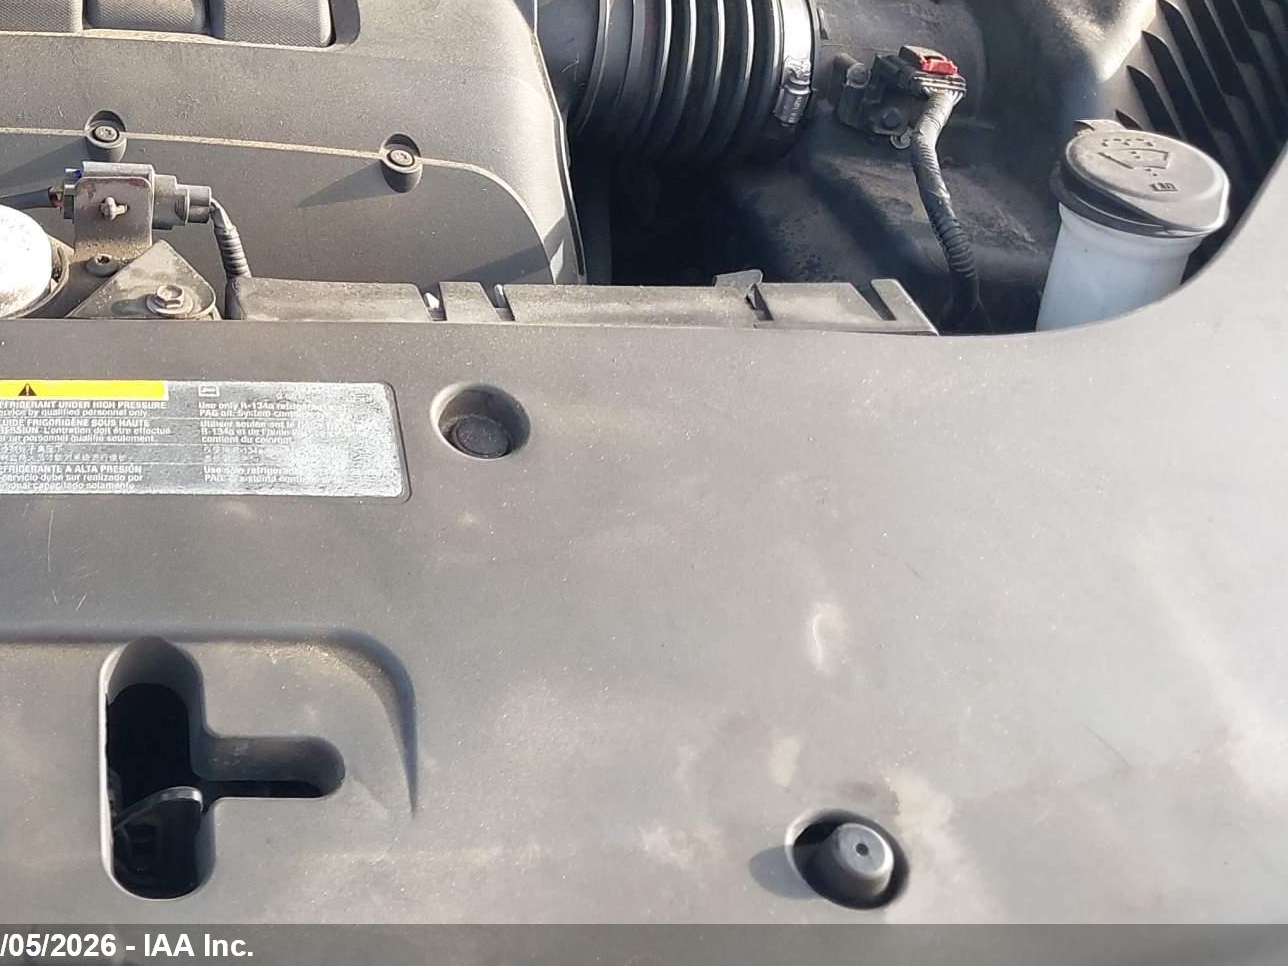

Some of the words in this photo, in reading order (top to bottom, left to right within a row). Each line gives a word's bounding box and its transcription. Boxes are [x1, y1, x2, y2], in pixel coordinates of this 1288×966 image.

[58, 401, 91, 409] UNDER
[92, 401, 116, 409] HIGH
[117, 401, 168, 410] PRESSURE
[198, 401, 217, 409] Use
[218, 401, 239, 411] only
[240, 401, 275, 410] R-134a
[28, 408, 39, 418] by
[41, 408, 80, 418] qualified
[82, 409, 127, 418] personnel
[199, 409, 219, 417] PAG
[237, 409, 272, 419] System
[27, 416, 90, 427] FRIGORIGÈNE
[91, 418, 117, 427] SOUS
[118, 419, 151, 427] HAUTE
[200, 420, 233, 428] Utiliser
[93, 426, 111, 435] doit
[201, 427, 235, 436] R-134a
[22, 434, 69, 444] personnel
[201, 435, 240, 443] contient
[240, 435, 254, 443] du
[64, 465, 73, 473] A
[74, 465, 99, 474] ALTA
[99, 463, 143, 474] PRESIÓN
[203, 465, 222, 474] Use
[40, 474, 64, 482] debe
[83, 474, 126, 482] realizado
[127, 474, 143, 484] por
